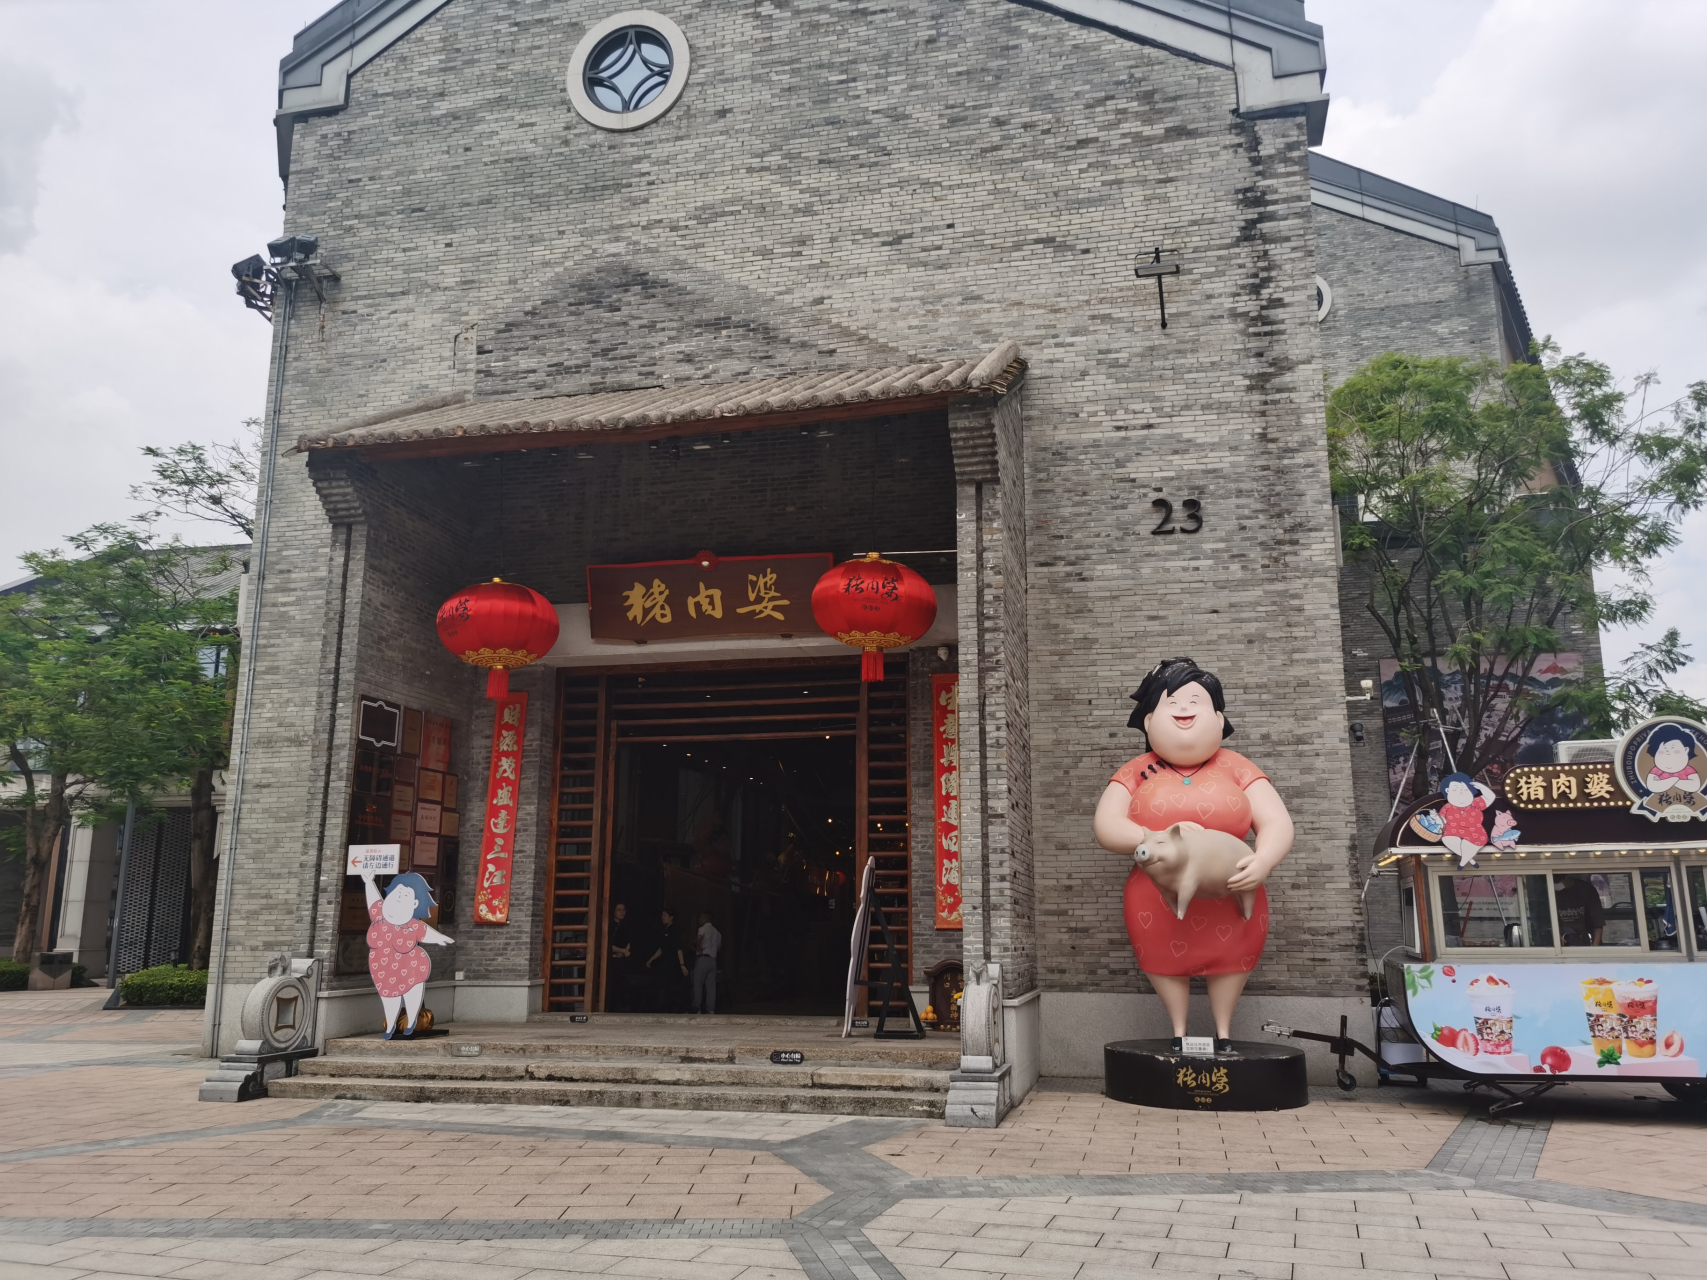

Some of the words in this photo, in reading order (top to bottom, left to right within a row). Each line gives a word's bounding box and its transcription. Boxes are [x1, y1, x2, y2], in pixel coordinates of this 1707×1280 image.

[1151, 498, 1203, 535] 23
[622, 567, 791, 626] 猪肉婆
[844, 573, 899, 602] 猪肉婆
[1516, 771, 1615, 801] 猪肉婆
[1657, 791, 1697, 807] 猪肉婆
[362, 861, 395, 869] 请左边通行
[363, 854, 395, 862] 无障碍通道
[1175, 1064, 1230, 1094] 猪肉婆
